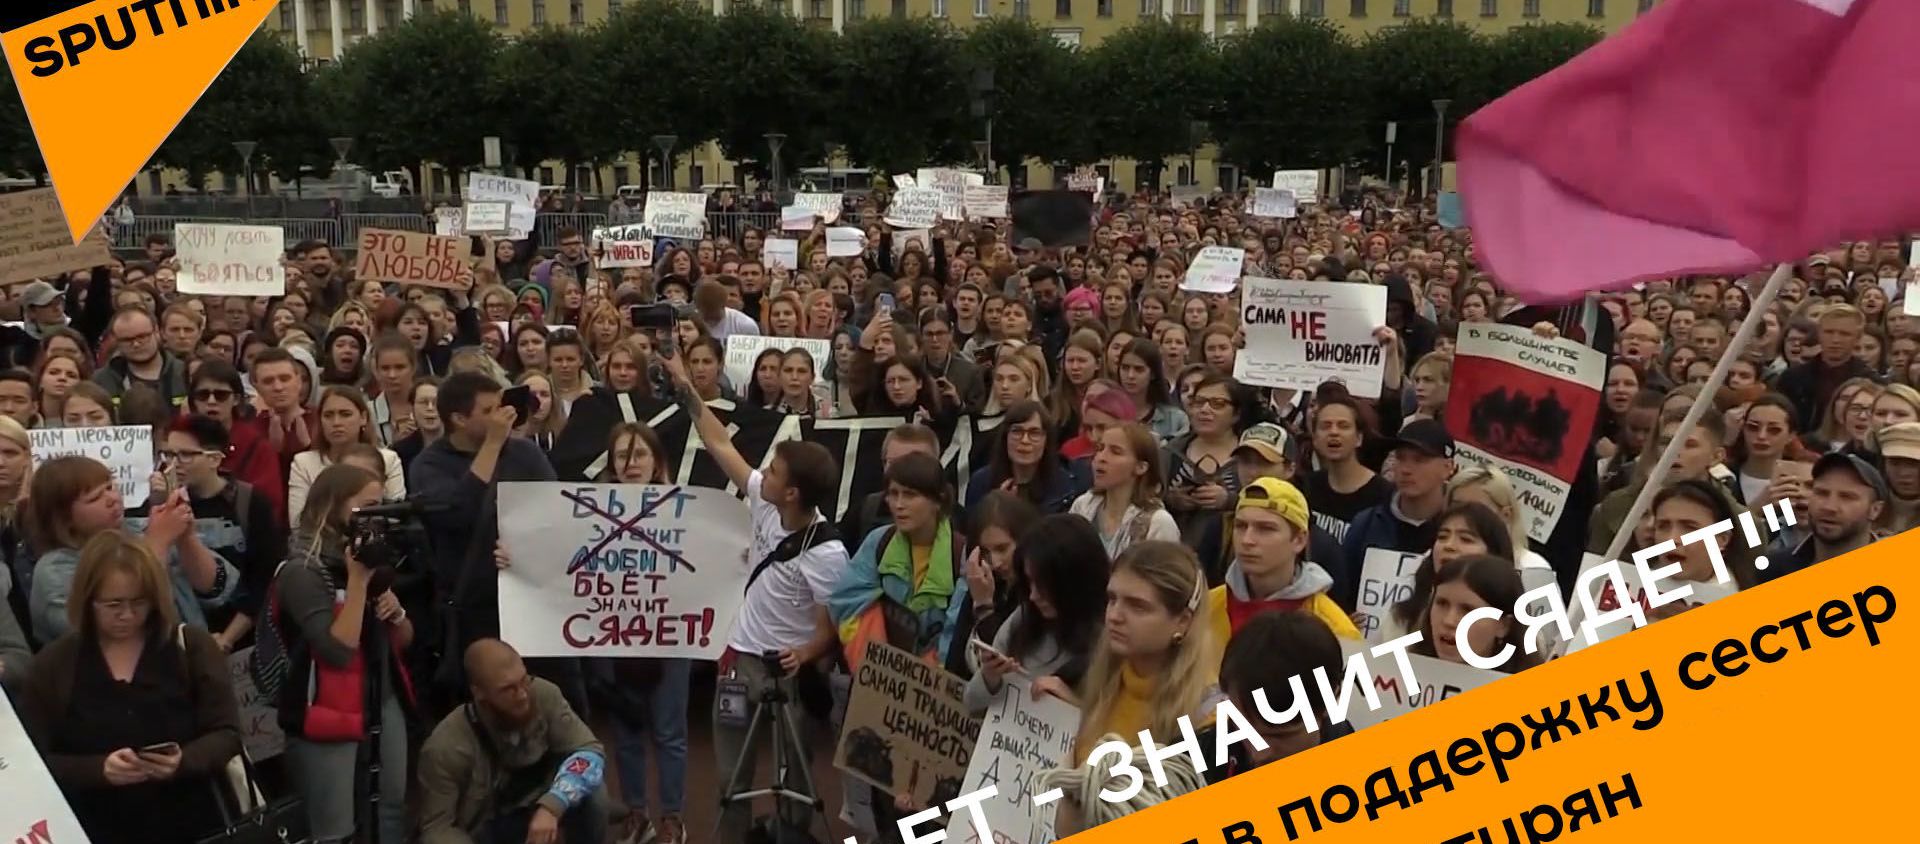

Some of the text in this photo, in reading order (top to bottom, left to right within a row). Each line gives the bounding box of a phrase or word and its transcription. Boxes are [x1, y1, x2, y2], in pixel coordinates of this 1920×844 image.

[364, 233, 457, 258] ЭТО НЕ
[360, 253, 467, 284] ЛЮБОВЬ
[1244, 305, 1327, 341] САМА НЕ
[1469, 329, 1480, 338] В
[1305, 341, 1381, 366] ВИНОВАТА
[1518, 351, 1577, 375] СЛУЧАЕВ
[30, 430, 64, 447] НАМ
[572, 487, 697, 518] БЬЁТ
[569, 545, 683, 573] ЛЮБИТ
[573, 570, 667, 597] БЬЁТ
[586, 597, 669, 614] ЗНАЧИТ
[562, 608, 715, 648] СЯДЕТ!
[865, 641, 933, 687] НЕНАВИСТЬ
[859, 665, 907, 703] САМАЯ
[883, 704, 969, 767] ЦЕННОСТЬ
